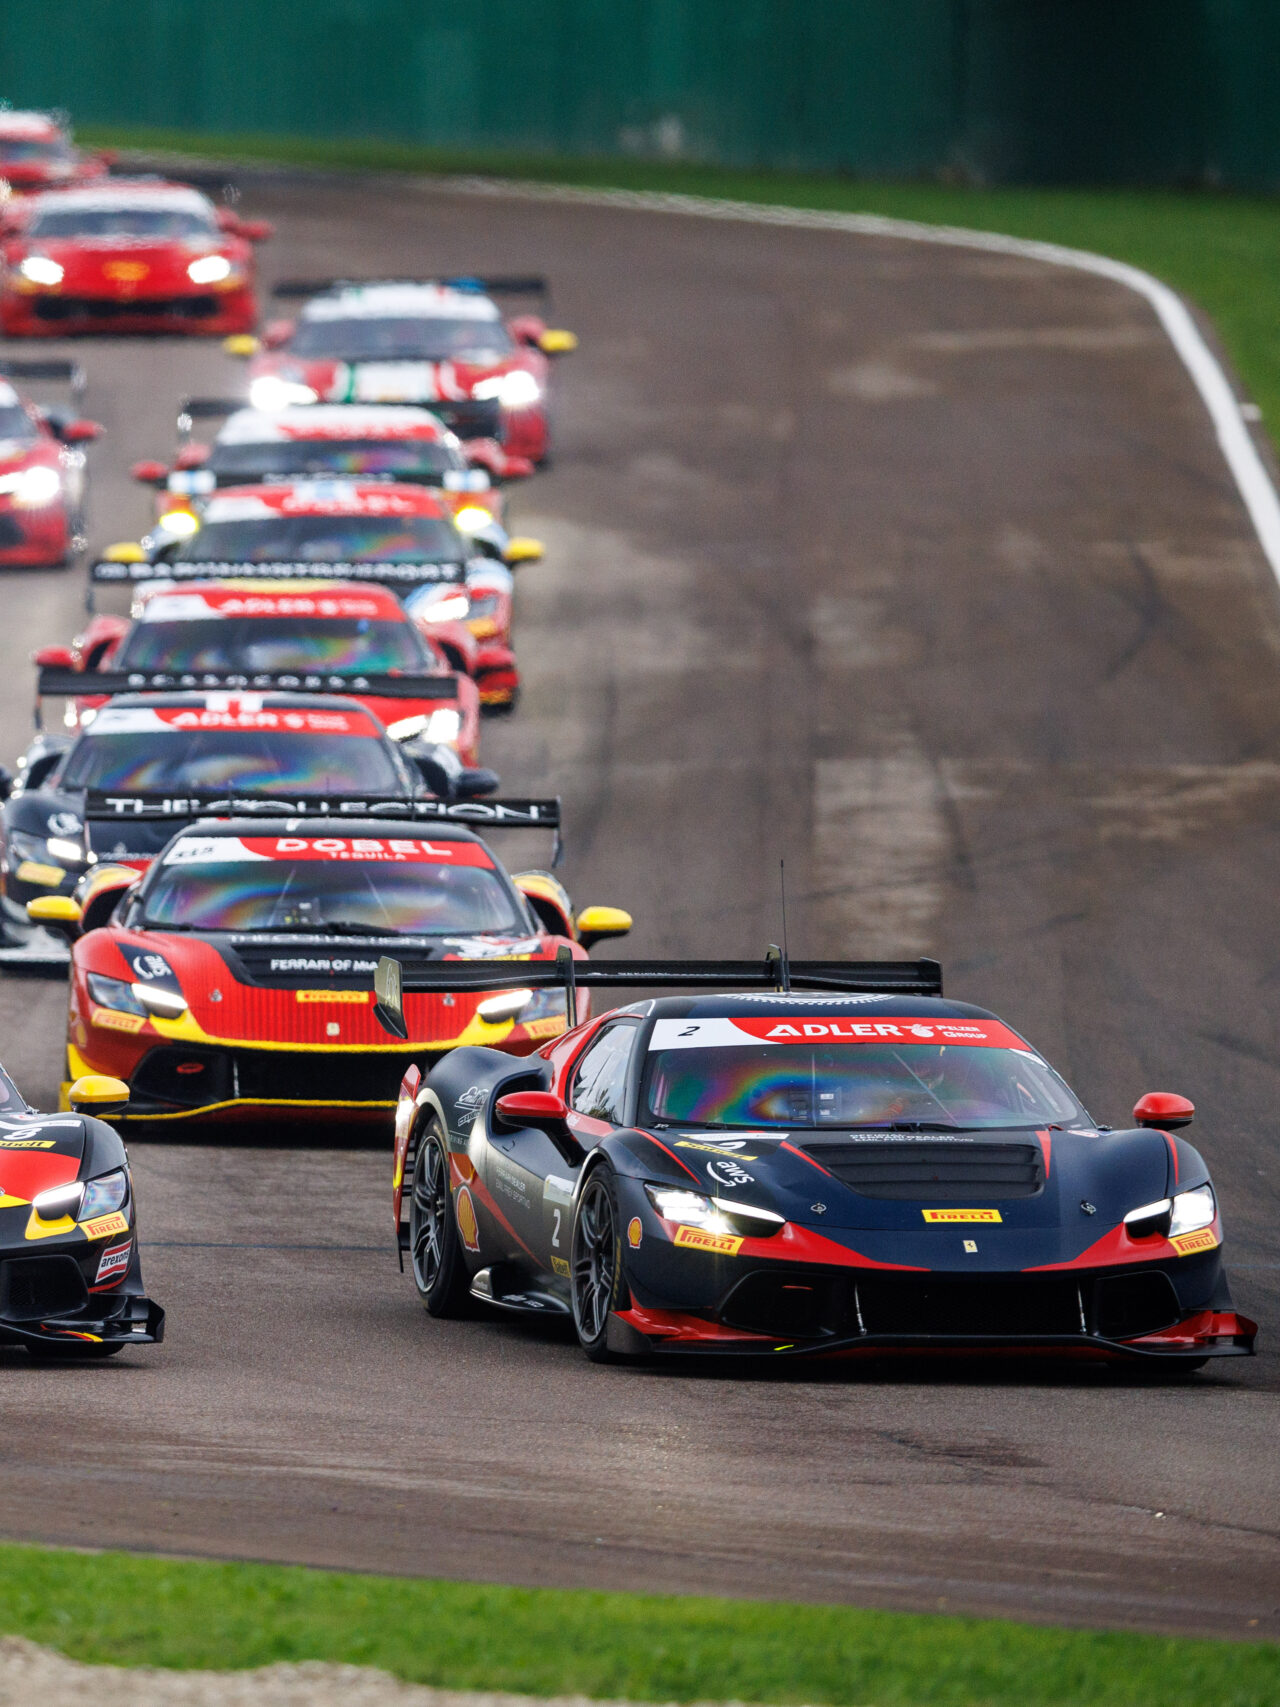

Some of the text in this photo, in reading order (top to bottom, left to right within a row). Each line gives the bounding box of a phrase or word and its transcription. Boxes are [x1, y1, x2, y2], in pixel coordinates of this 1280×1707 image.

[276, 838, 453, 856] DOBEL
[270, 958, 379, 971] FERRARI OF MIA
[677, 1024, 980, 1037] 2 ADLER PELZER
[942, 1031, 988, 1039] GROUP
[717, 1161, 755, 1184] aws
[930, 1211, 994, 1220] PIRELLI
[86, 1216, 125, 1236] PIRELLI
[552, 1208, 562, 1249] 2
[680, 1229, 736, 1251] PIRELLI
[1176, 1232, 1216, 1252] PIRELLI
[100, 1250, 130, 1268] arexons
